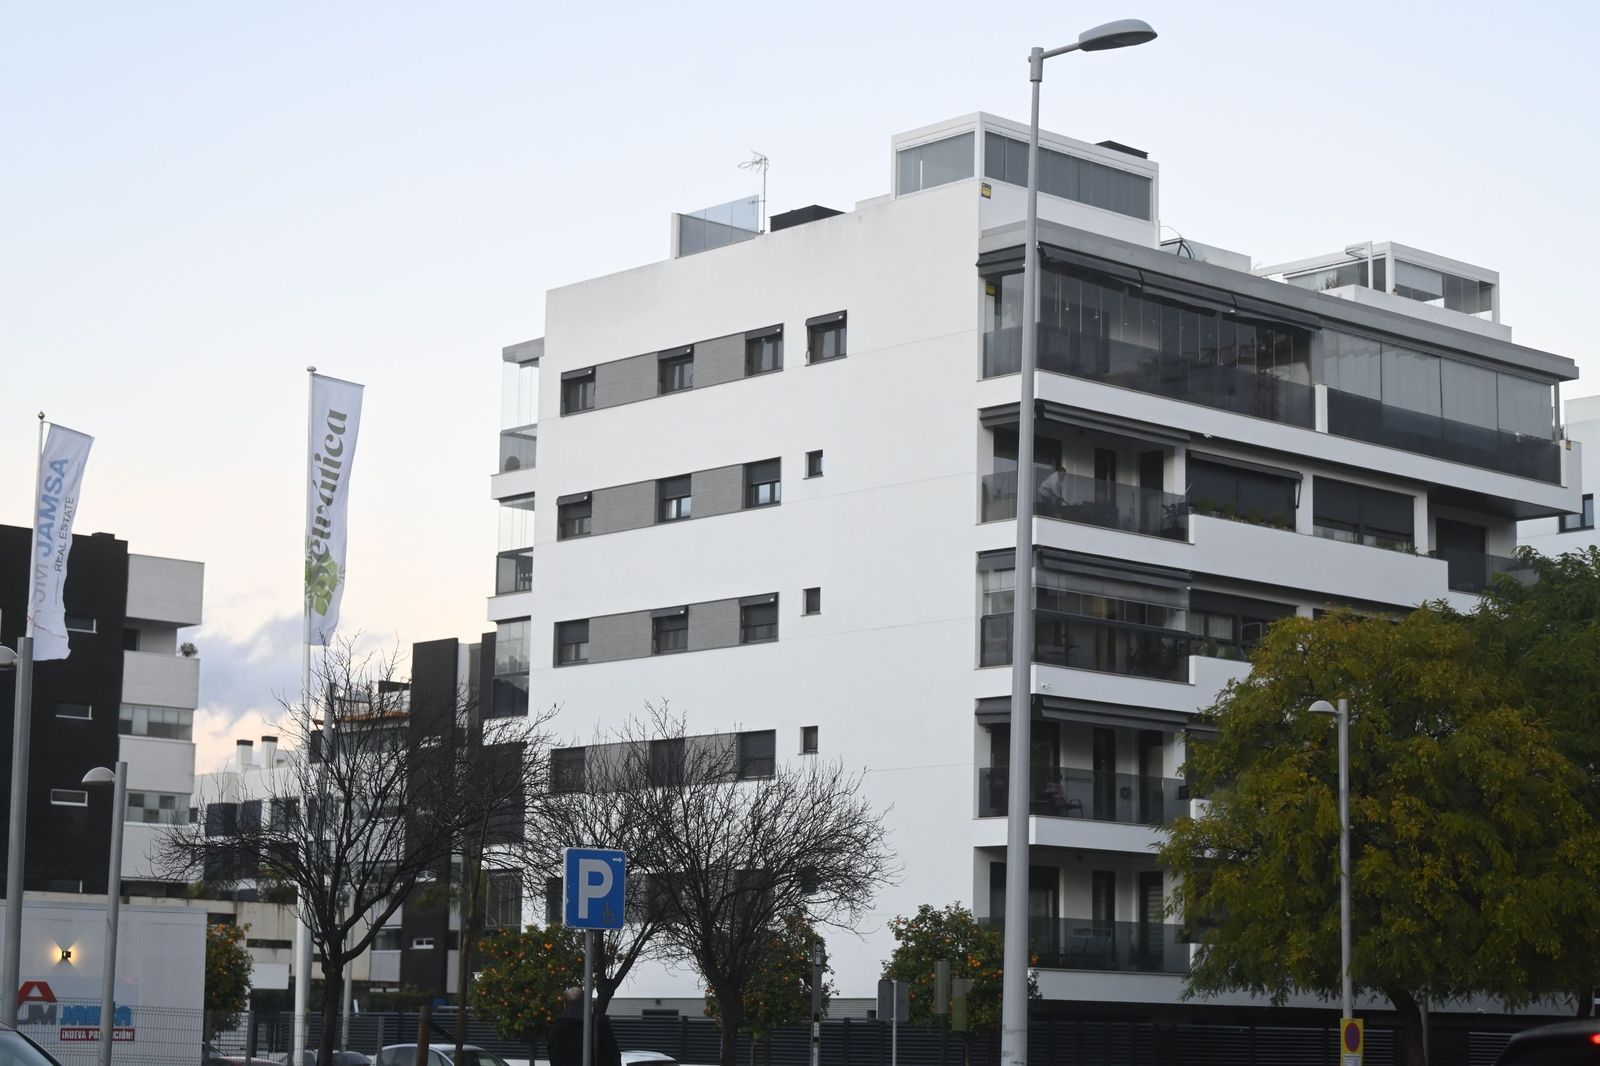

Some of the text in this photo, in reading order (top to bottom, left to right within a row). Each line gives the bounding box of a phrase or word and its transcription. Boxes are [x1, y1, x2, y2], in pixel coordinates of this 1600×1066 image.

[36, 457, 70, 558] JAMSA
[54, 496, 75, 573] REAL ESTATE
[578, 858, 614, 919] P
[61, 1004, 132, 1026] JAMA
[89, 1030, 134, 1040] PRCIÓN!
